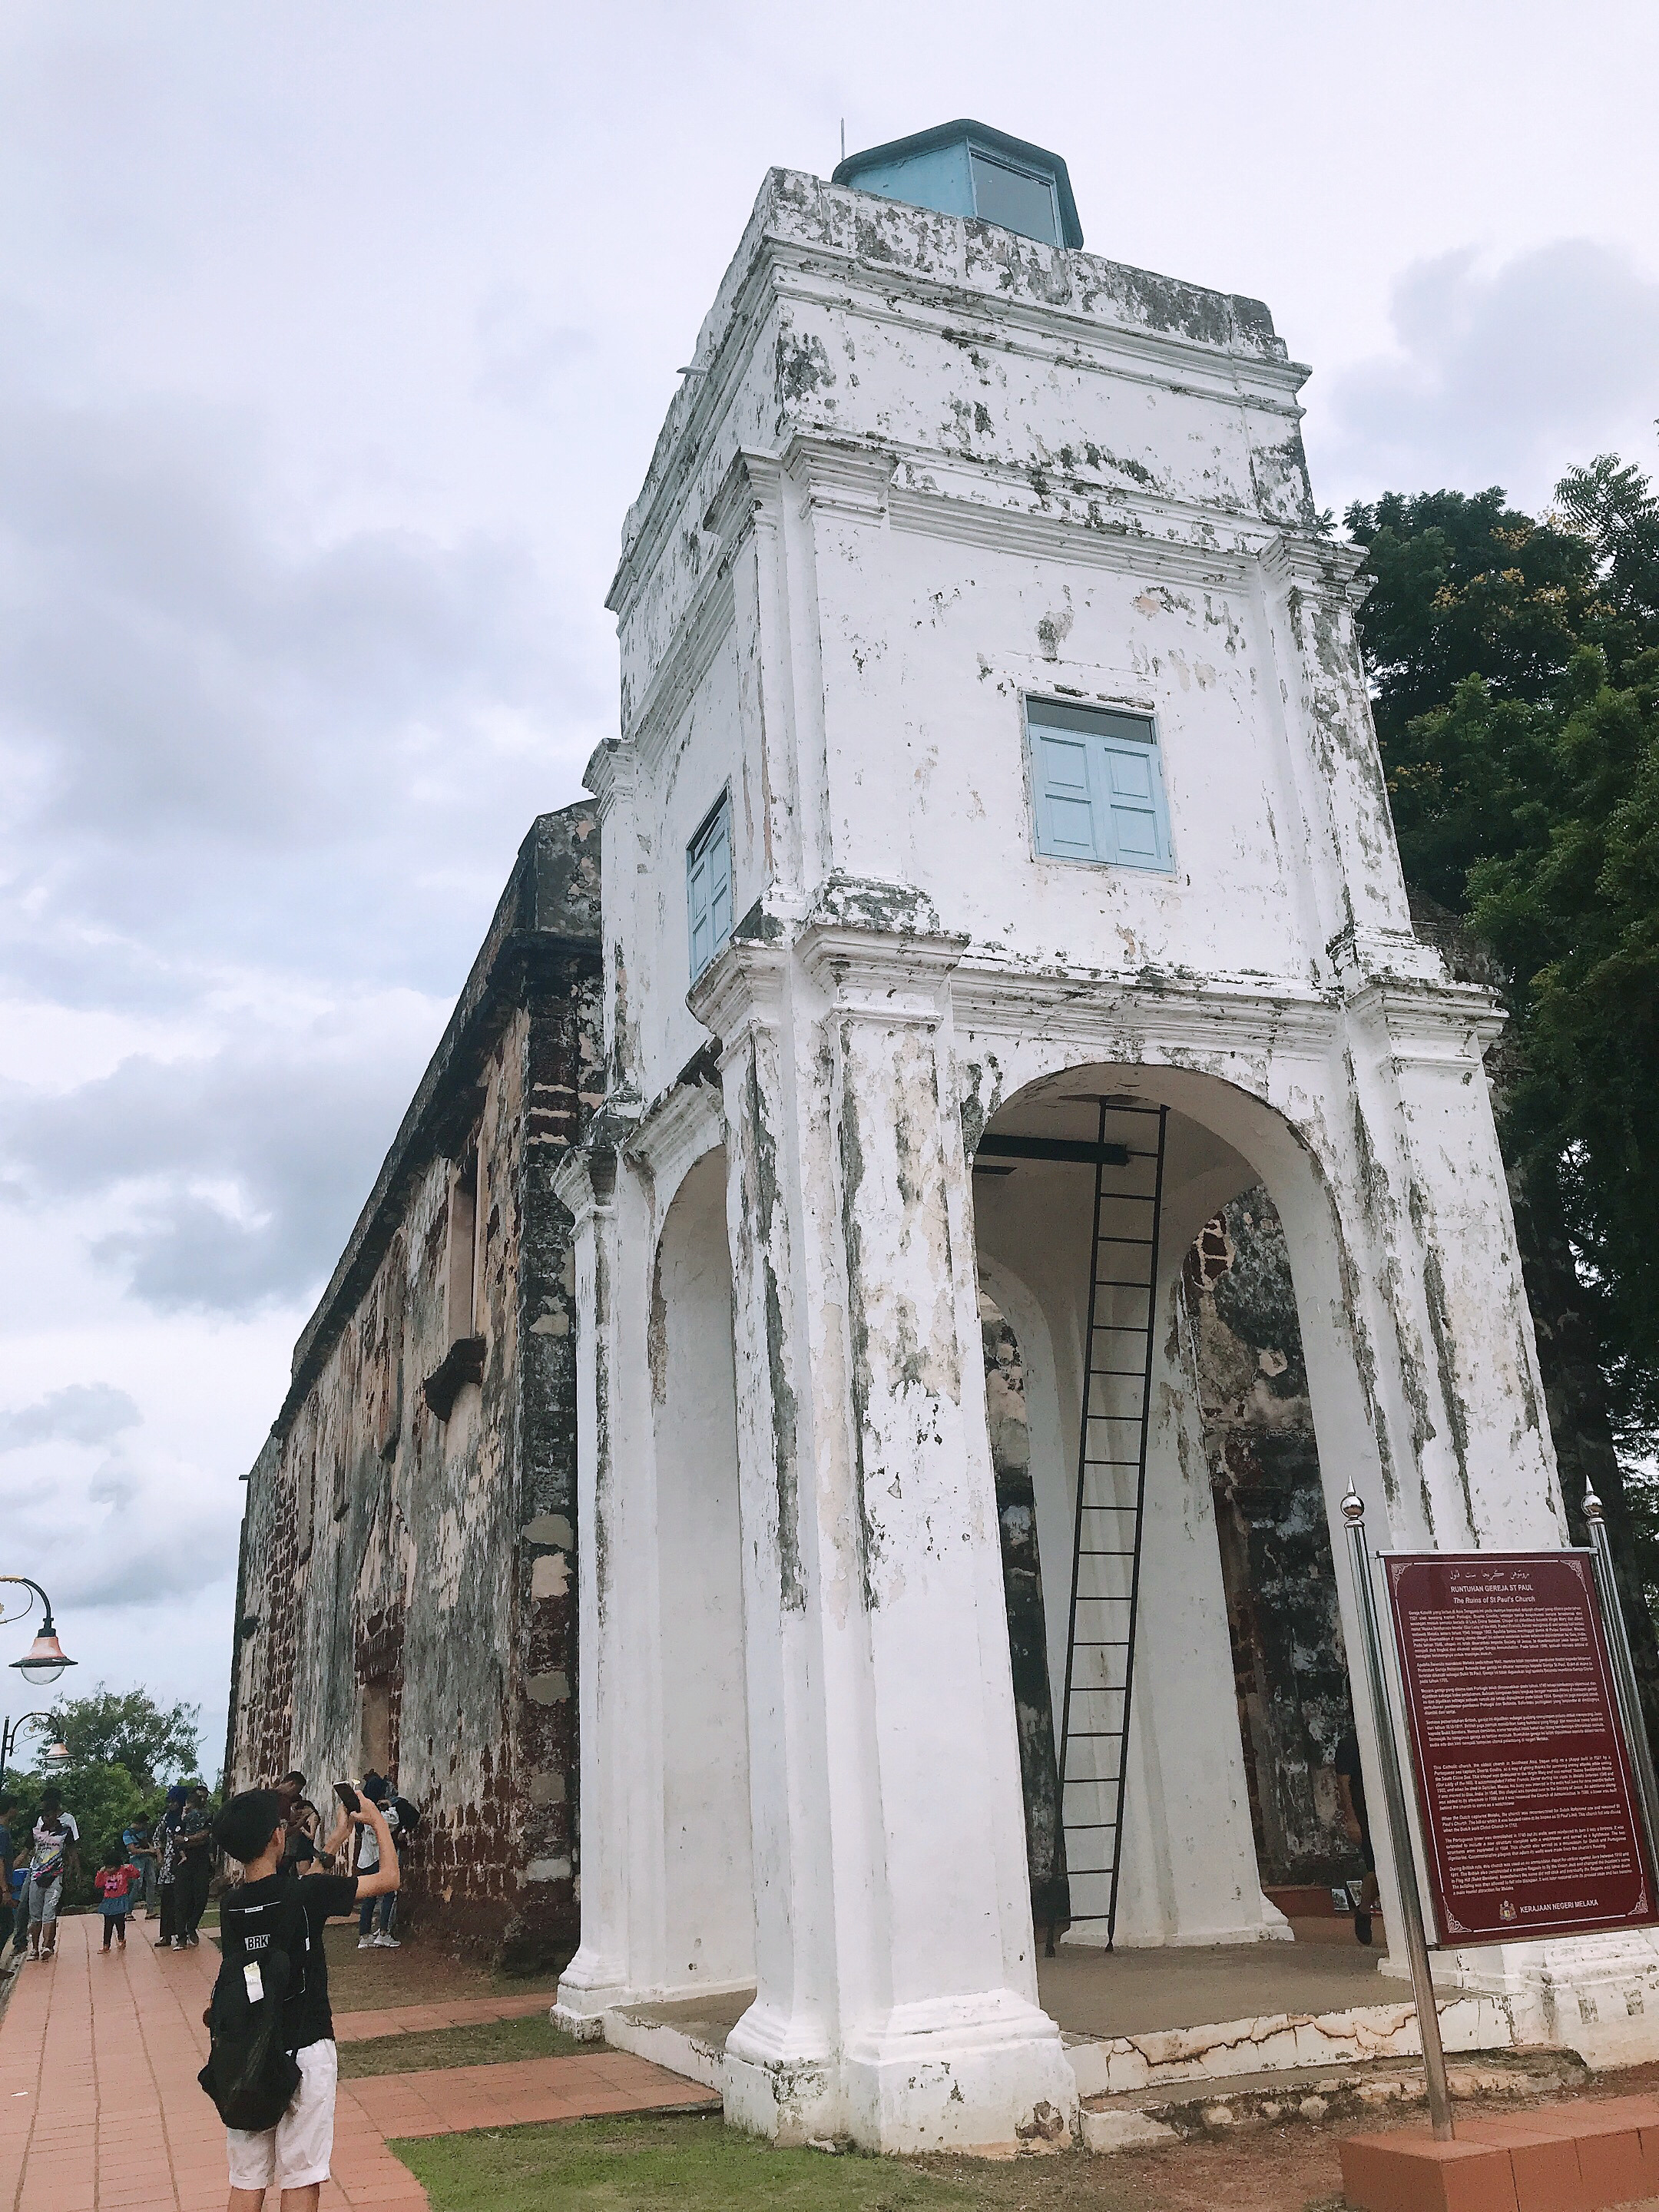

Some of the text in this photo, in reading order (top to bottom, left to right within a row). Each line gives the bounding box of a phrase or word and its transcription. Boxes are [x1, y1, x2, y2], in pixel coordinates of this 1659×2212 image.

[1520, 1899, 1598, 1913] KERAJAAN NEGERI MELAKA
